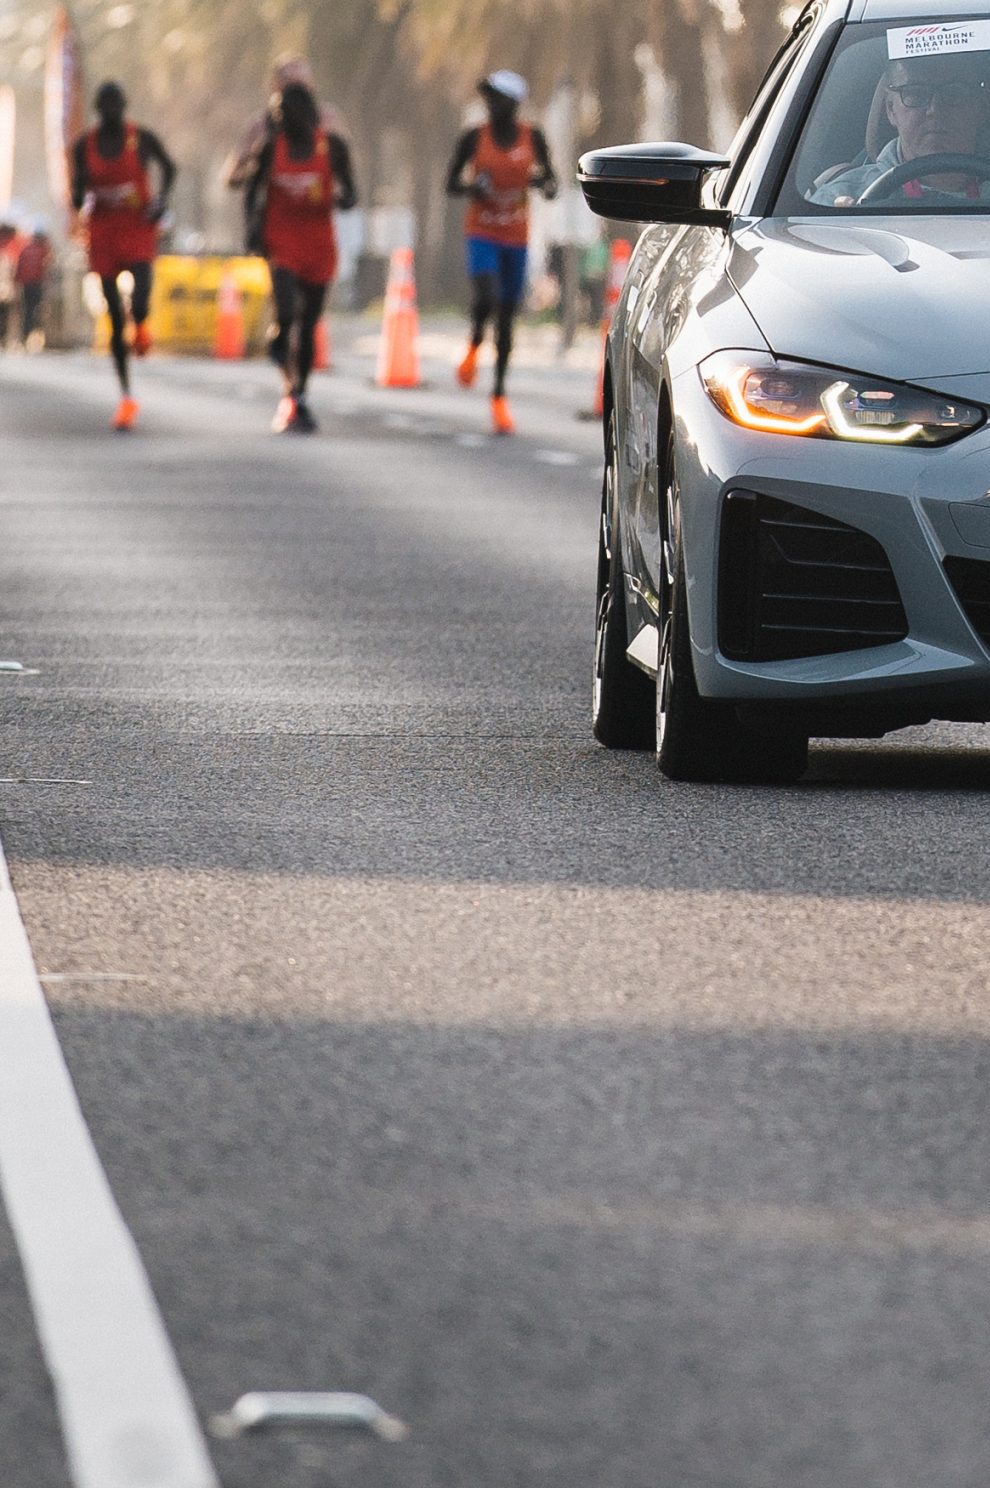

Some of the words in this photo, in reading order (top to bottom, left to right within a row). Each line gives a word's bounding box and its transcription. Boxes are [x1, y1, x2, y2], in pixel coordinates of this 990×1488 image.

[905, 31, 976, 44] MELBOURNE
[905, 38, 969, 50] MARATHON
[905, 47, 940, 55] FESTIVAL
